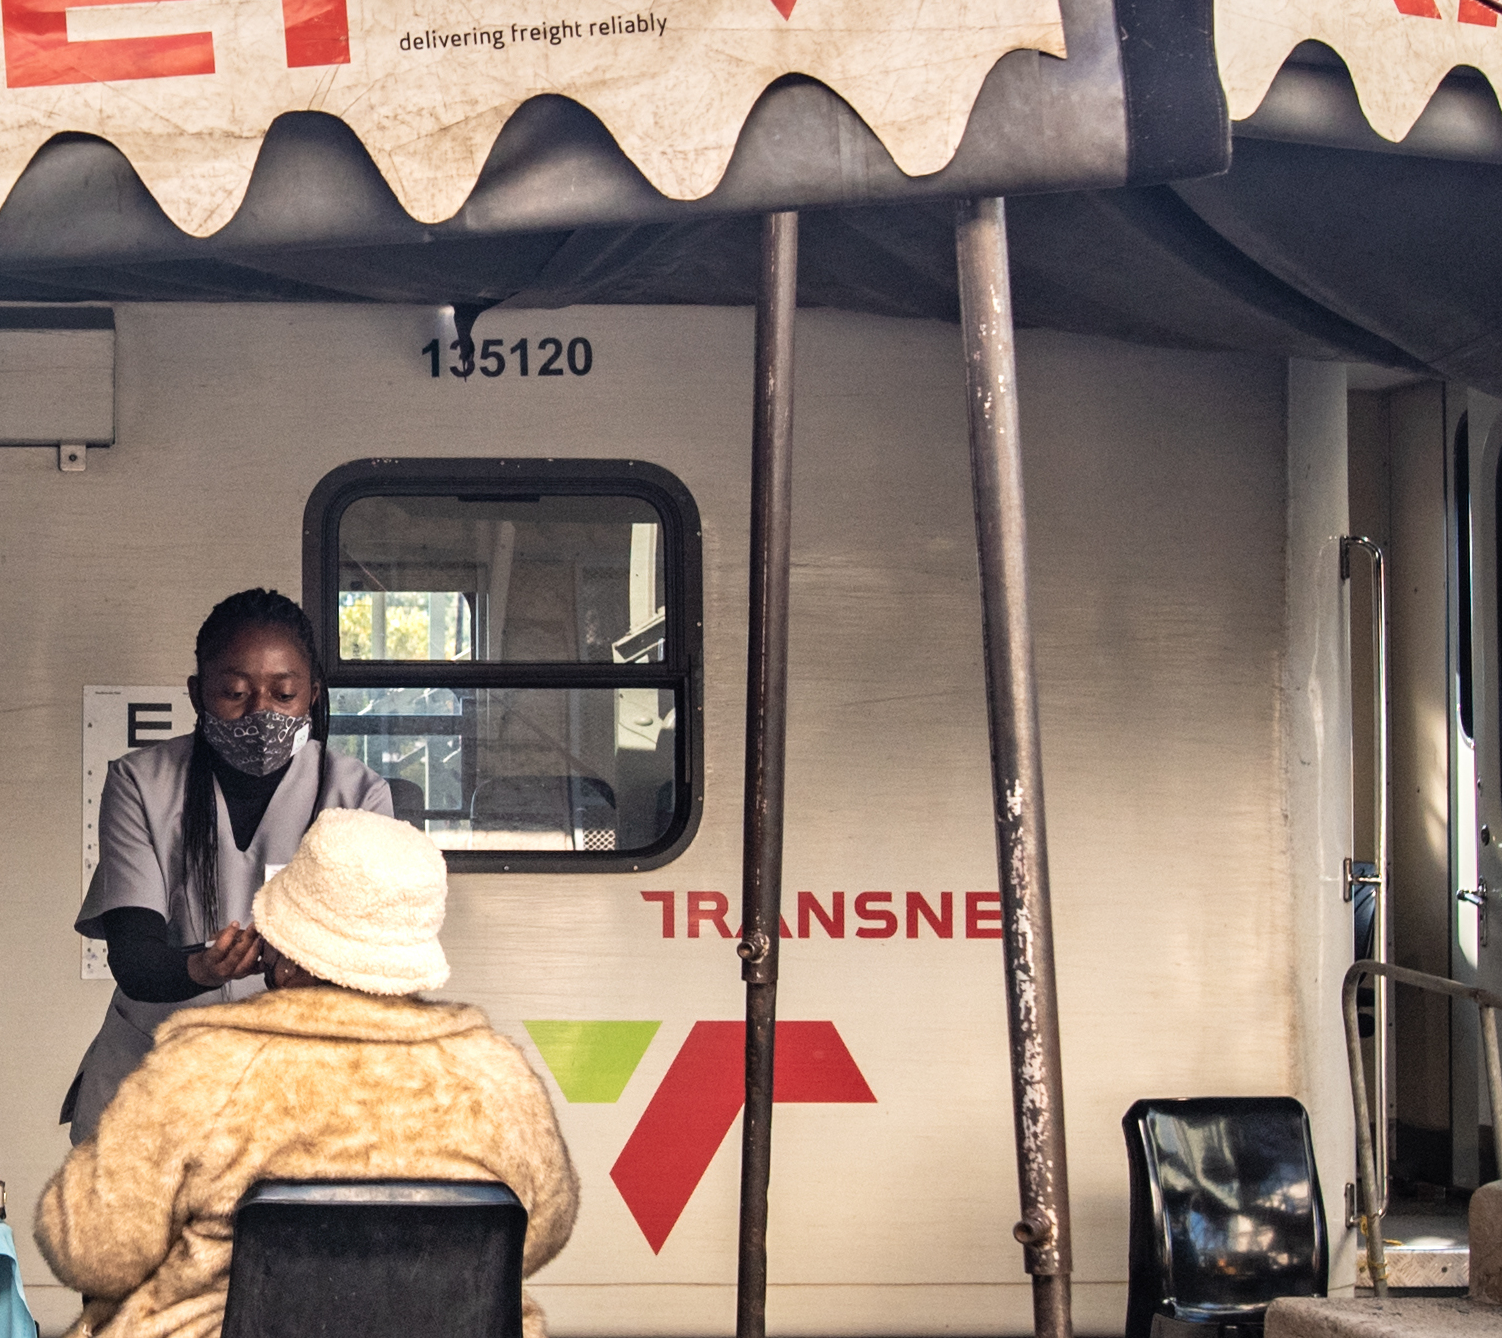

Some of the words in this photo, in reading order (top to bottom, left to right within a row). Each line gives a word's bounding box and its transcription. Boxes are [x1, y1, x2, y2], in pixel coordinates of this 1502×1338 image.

[399, 27, 505, 51] delivering
[511, 21, 582, 46] freight
[589, 12, 667, 37] reliably
[421, 337, 593, 377] 135120
[641, 891, 1002, 939] TRNSNE
